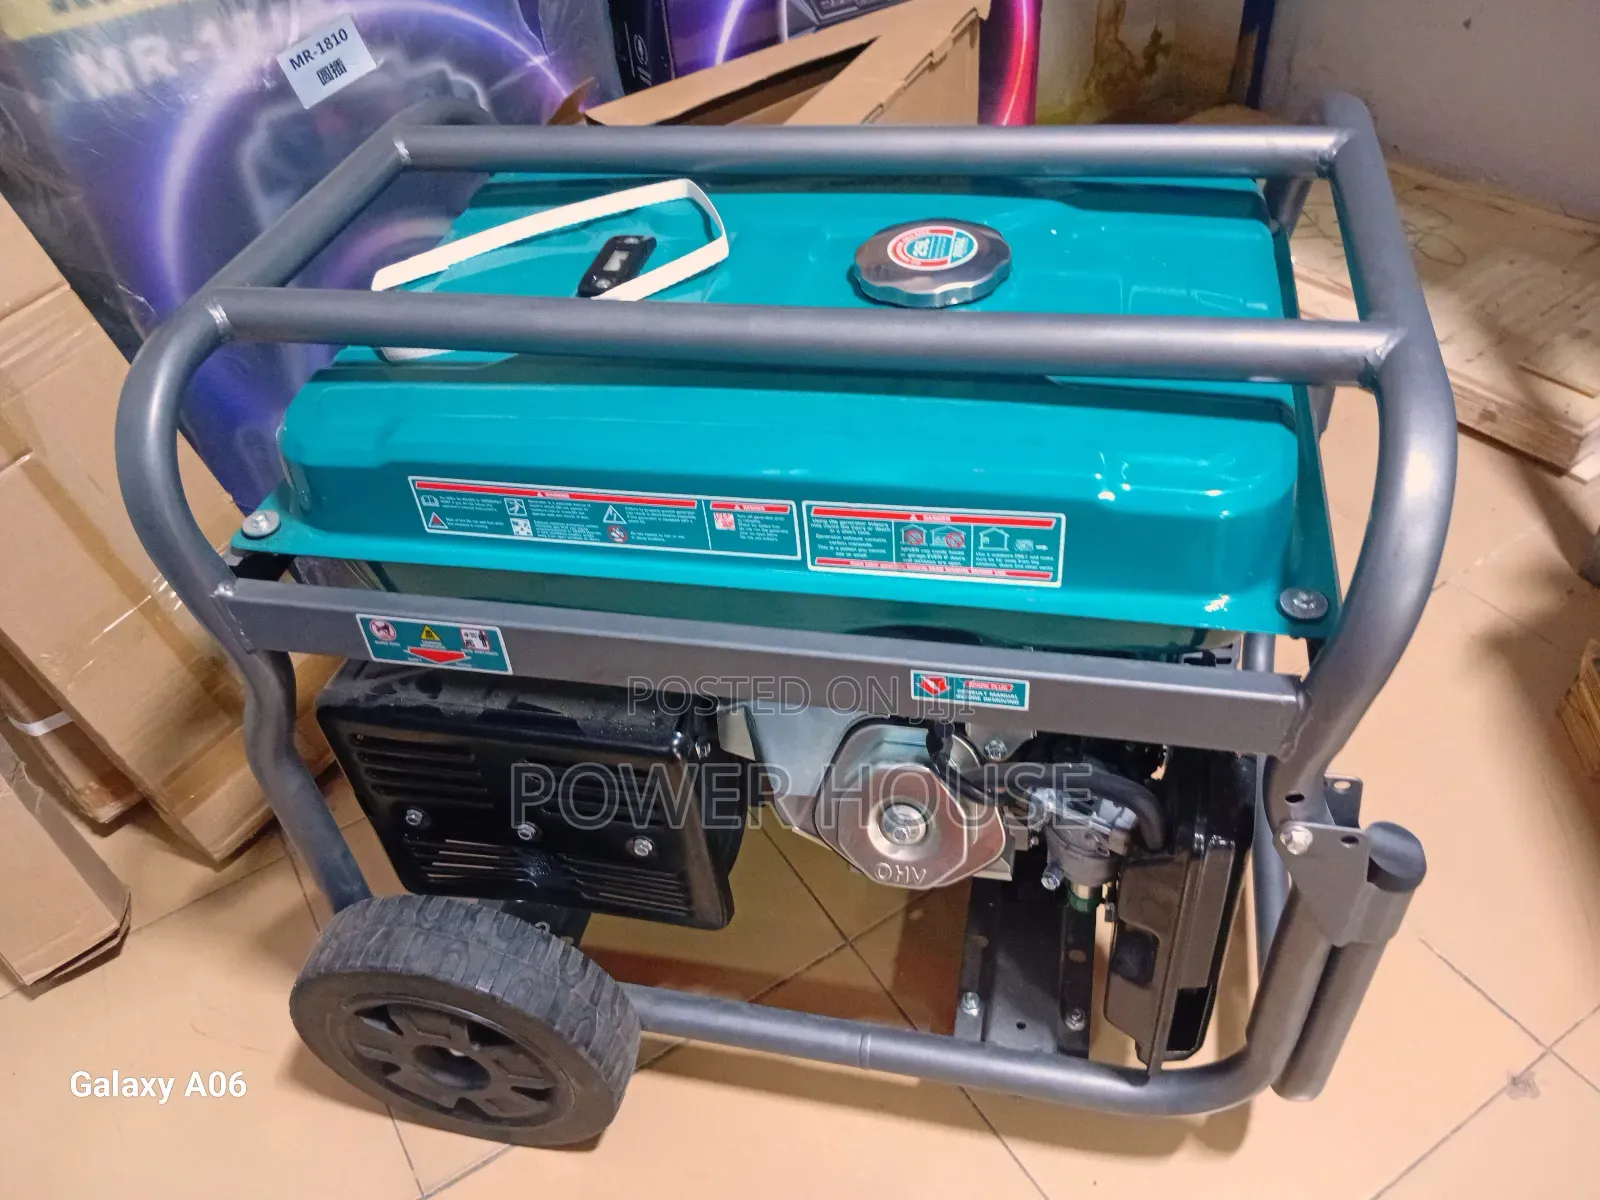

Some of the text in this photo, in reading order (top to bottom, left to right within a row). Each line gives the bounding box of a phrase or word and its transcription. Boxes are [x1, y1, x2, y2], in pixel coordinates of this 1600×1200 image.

[288, 27, 349, 71] MR-1810
[316, 58, 348, 86] 圆插
[875, 862, 927, 885] OHV
